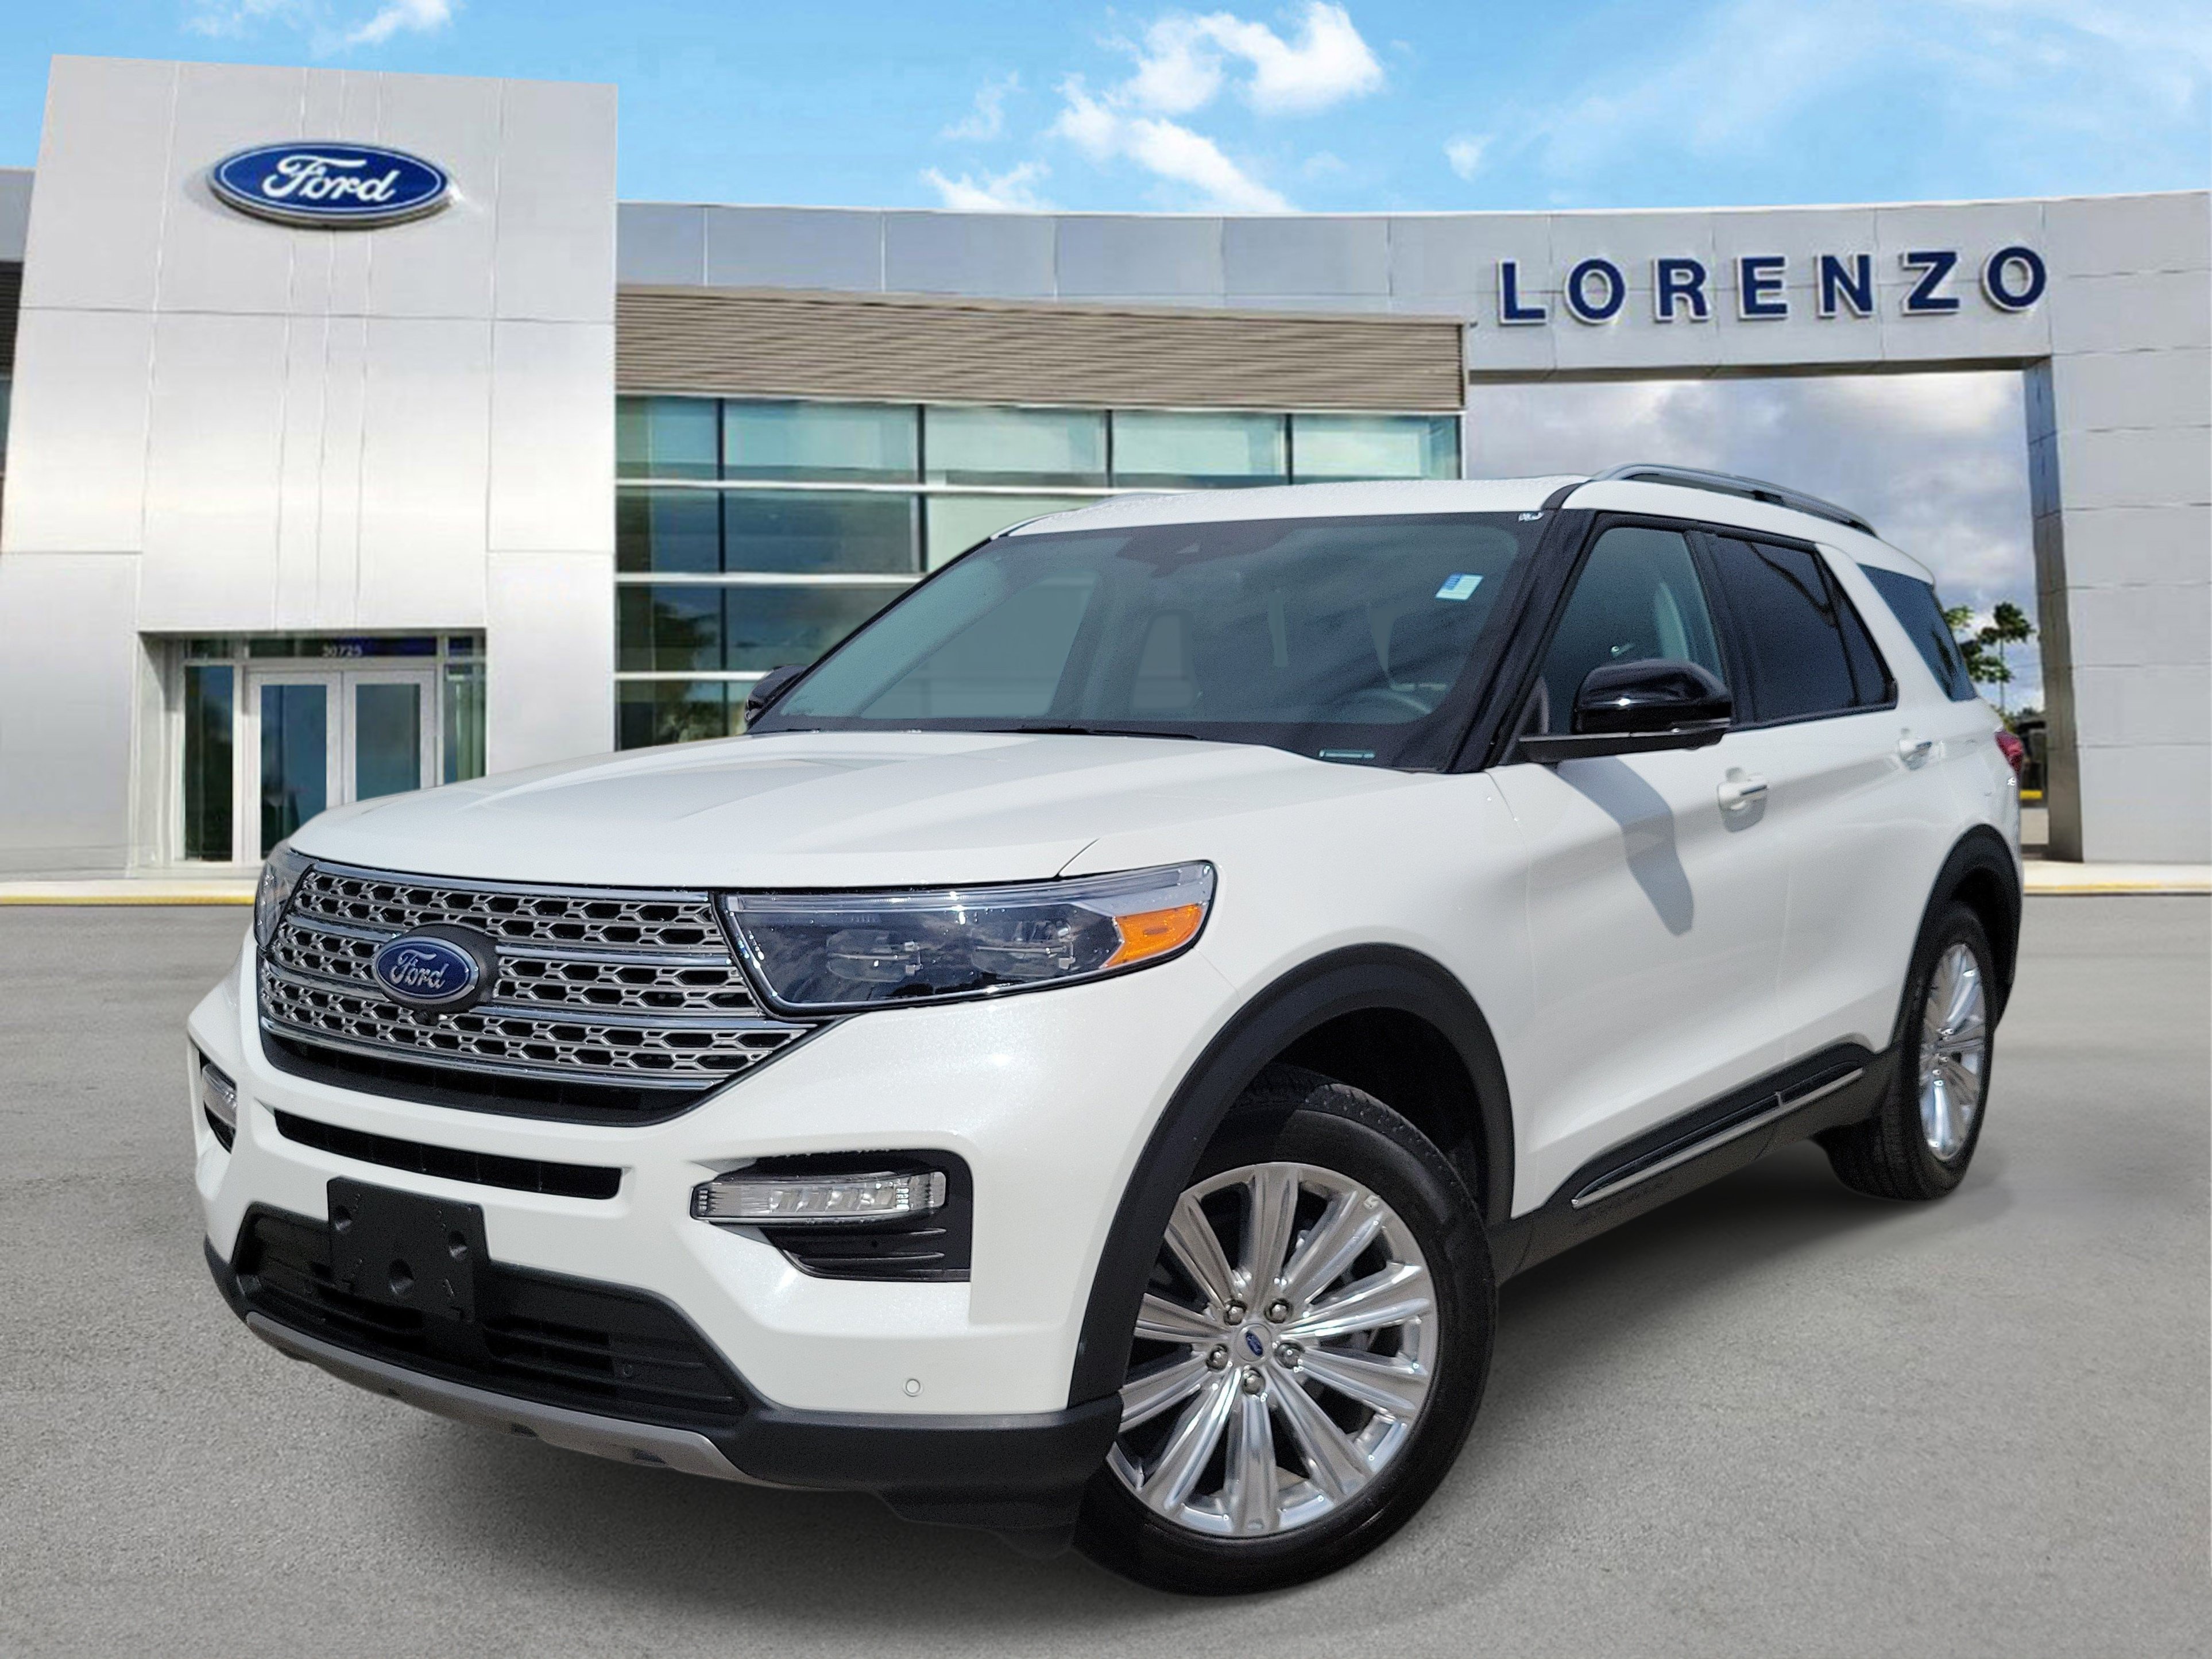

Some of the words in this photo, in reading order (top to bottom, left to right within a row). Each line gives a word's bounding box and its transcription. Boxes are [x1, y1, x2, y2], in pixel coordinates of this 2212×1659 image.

[262, 154, 400, 201] Ford
[1499, 246, 2048, 322] LORENZO
[390, 949, 449, 989] Ford
